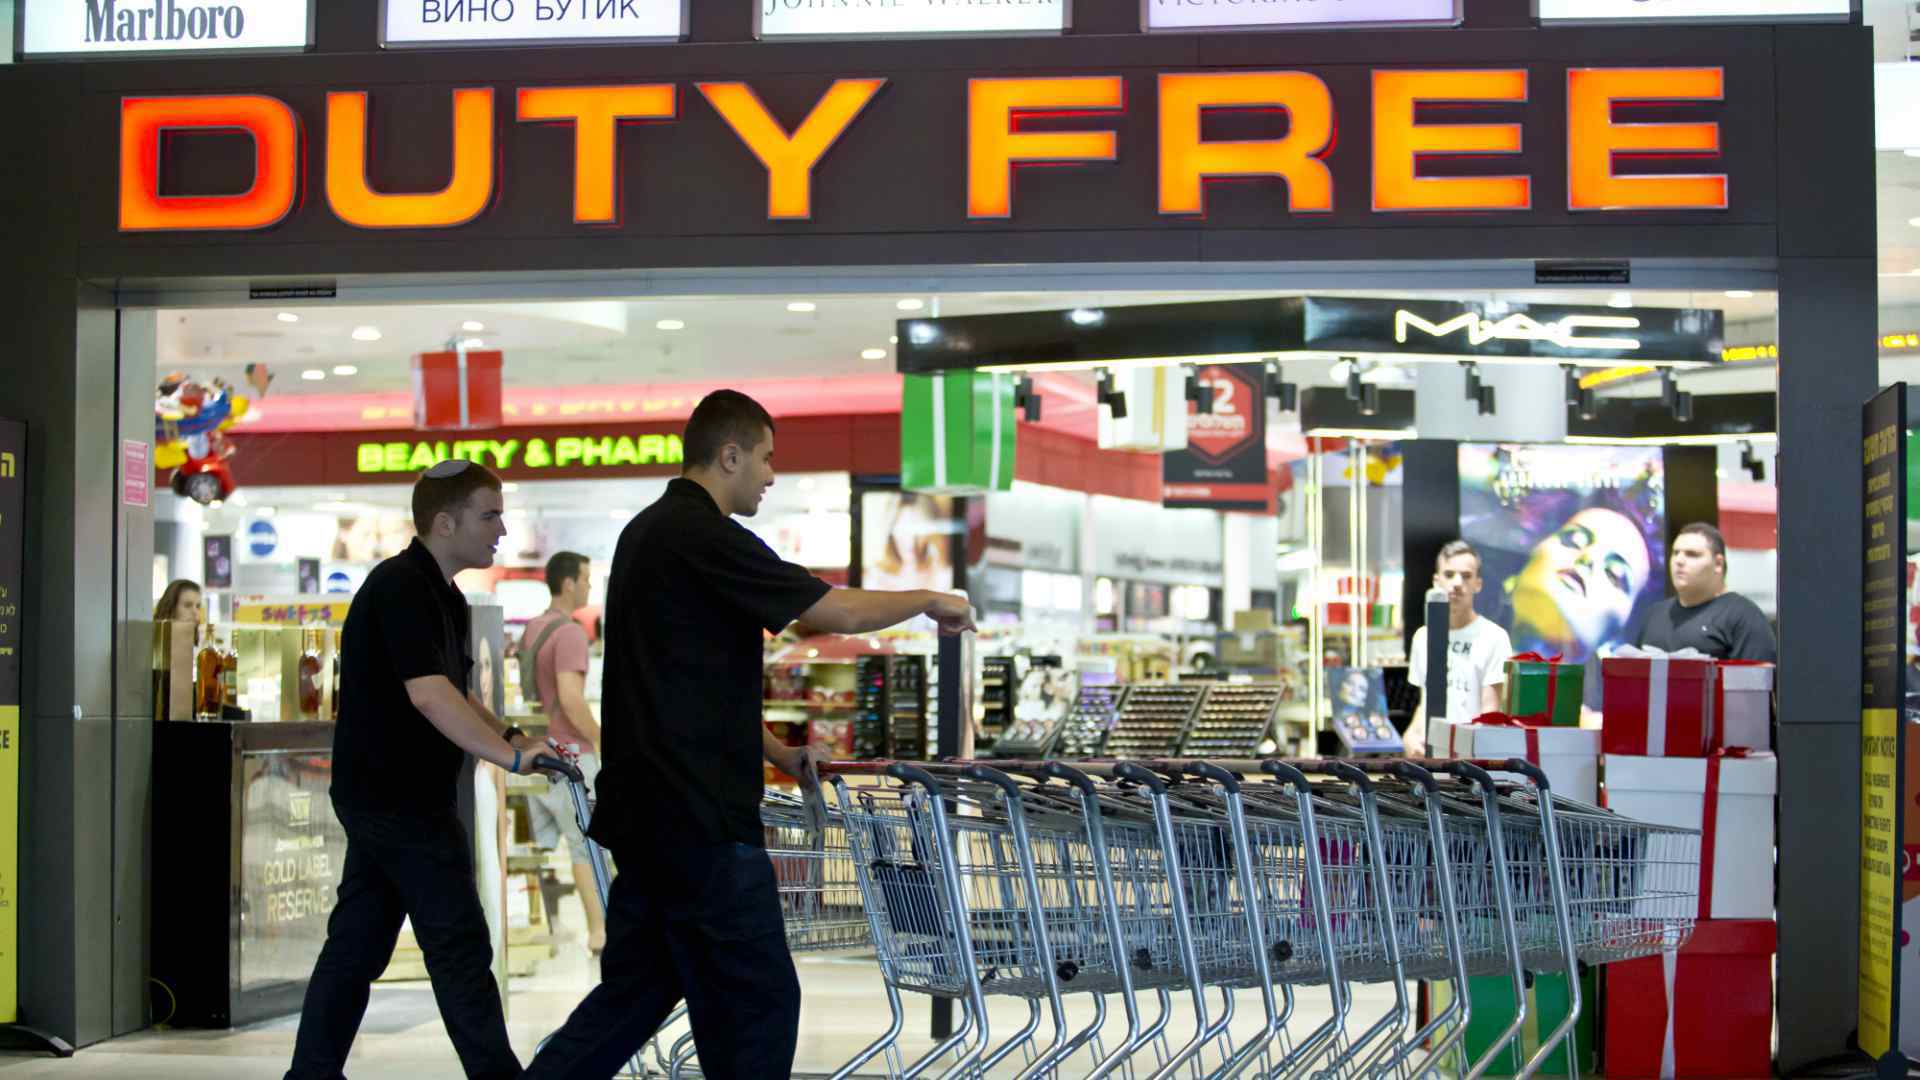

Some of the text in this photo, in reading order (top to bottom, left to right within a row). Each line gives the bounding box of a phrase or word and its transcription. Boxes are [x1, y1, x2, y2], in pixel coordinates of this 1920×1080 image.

[84, 0, 245, 42] Marlboro
[422, 0, 514, 23] ВИНО
[118, 66, 1729, 233] DUTY FREE
[357, 438, 519, 473] BEAUTY
[524, 437, 552, 467] &
[264, 853, 332, 886] GOLD LABEL
